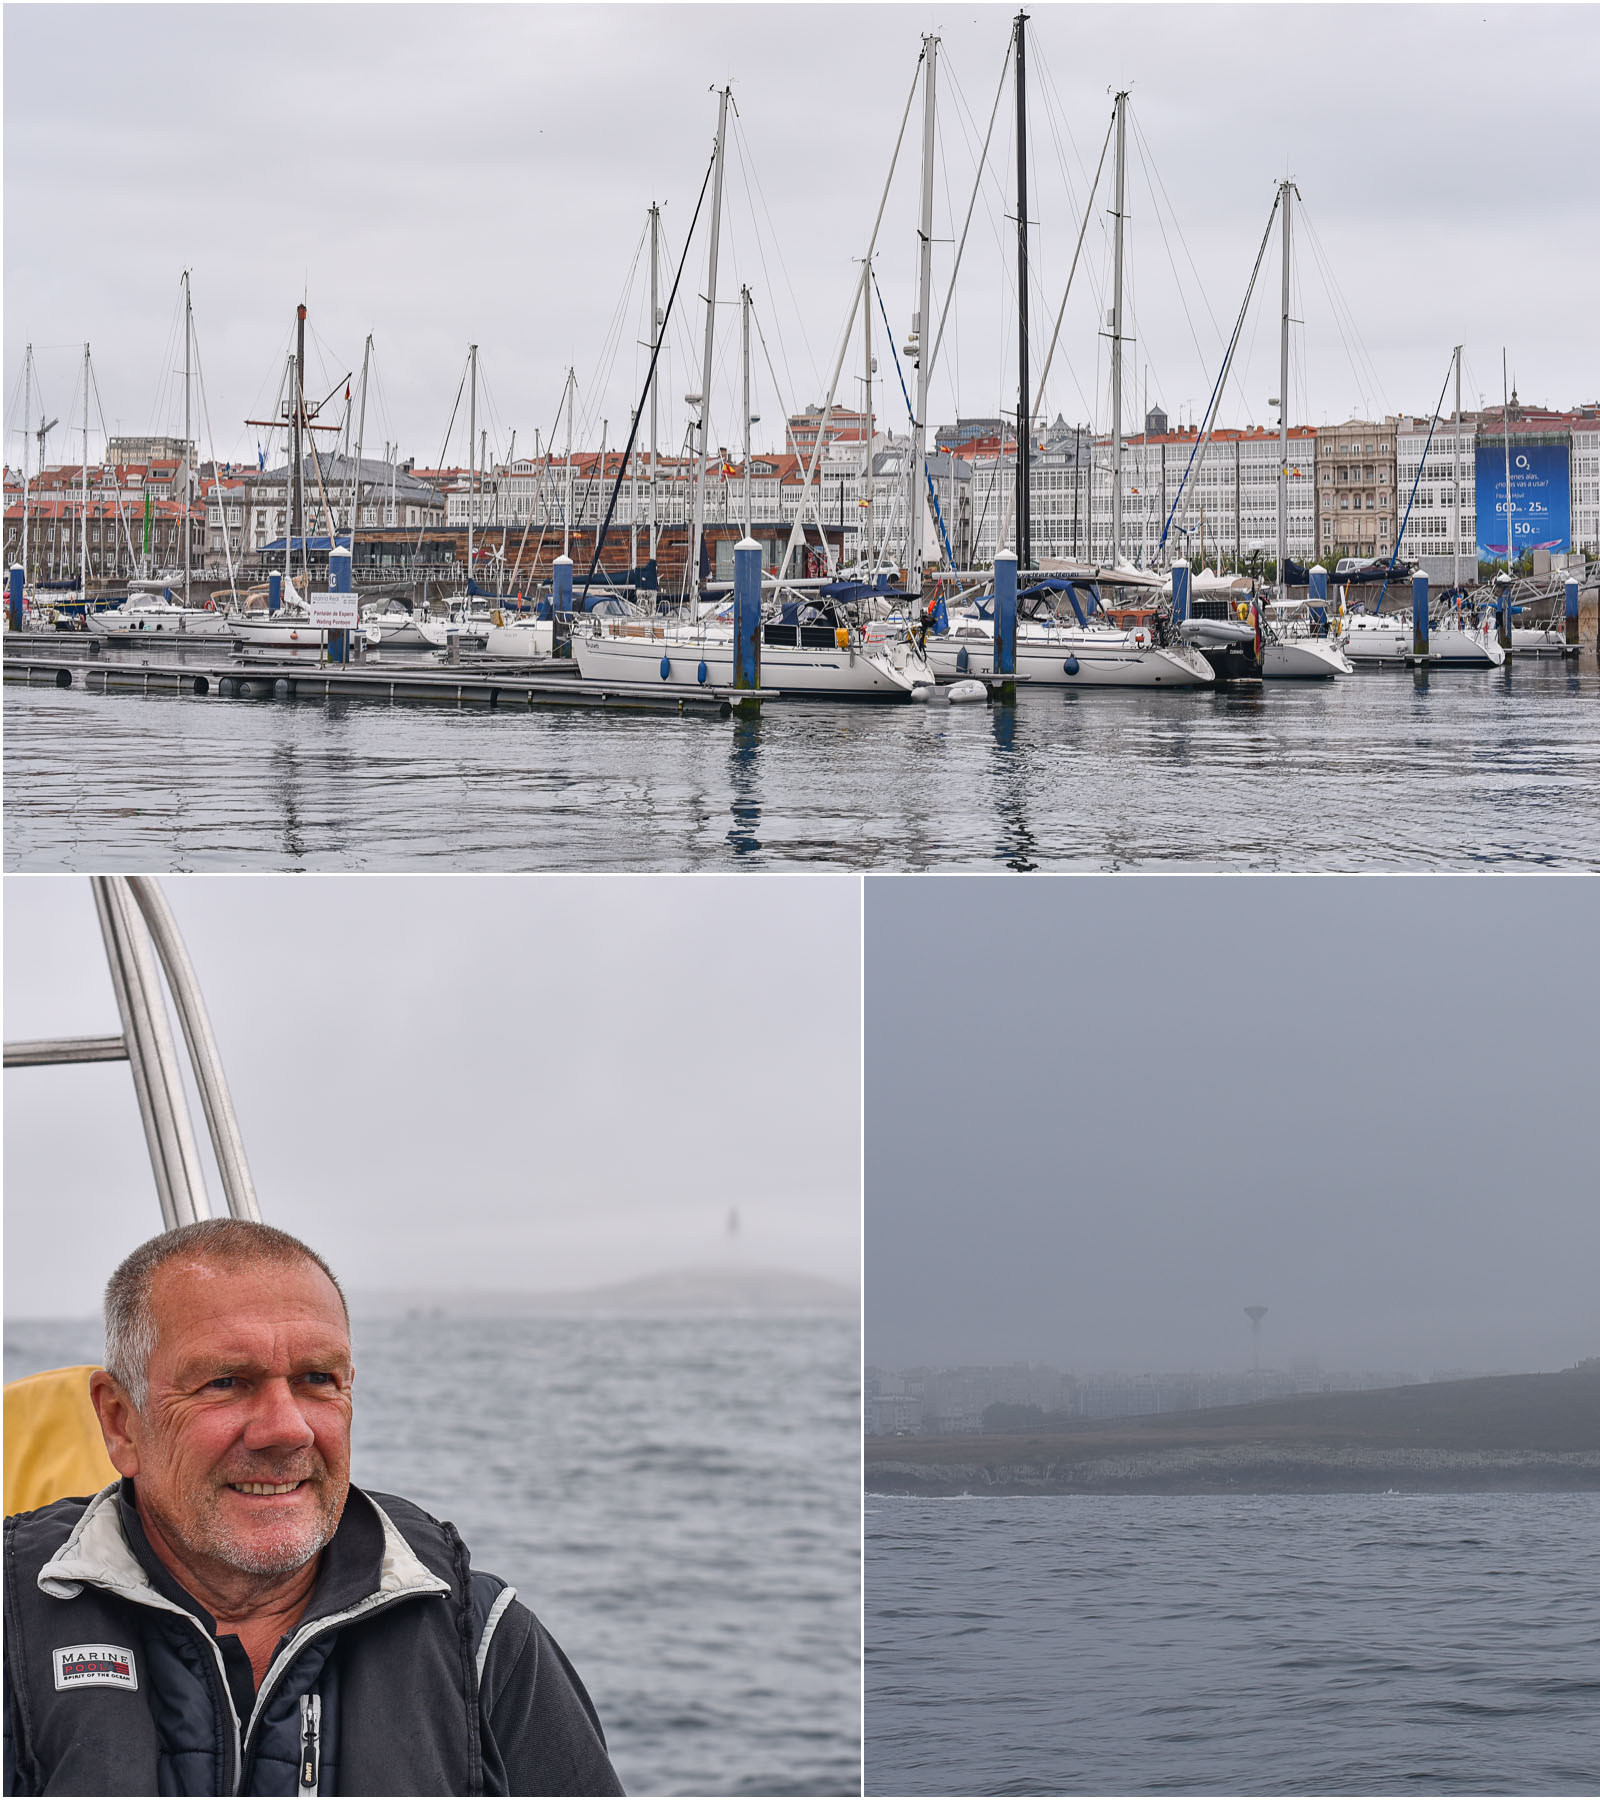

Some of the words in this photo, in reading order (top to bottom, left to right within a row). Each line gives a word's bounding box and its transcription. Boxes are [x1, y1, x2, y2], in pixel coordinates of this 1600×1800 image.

[62, 1652, 128, 1665] MARINE
[65, 1663, 107, 1675] POOL
[64, 1673, 85, 1681] SPIRIT
[110, 1673, 131, 1681] OCEAN
